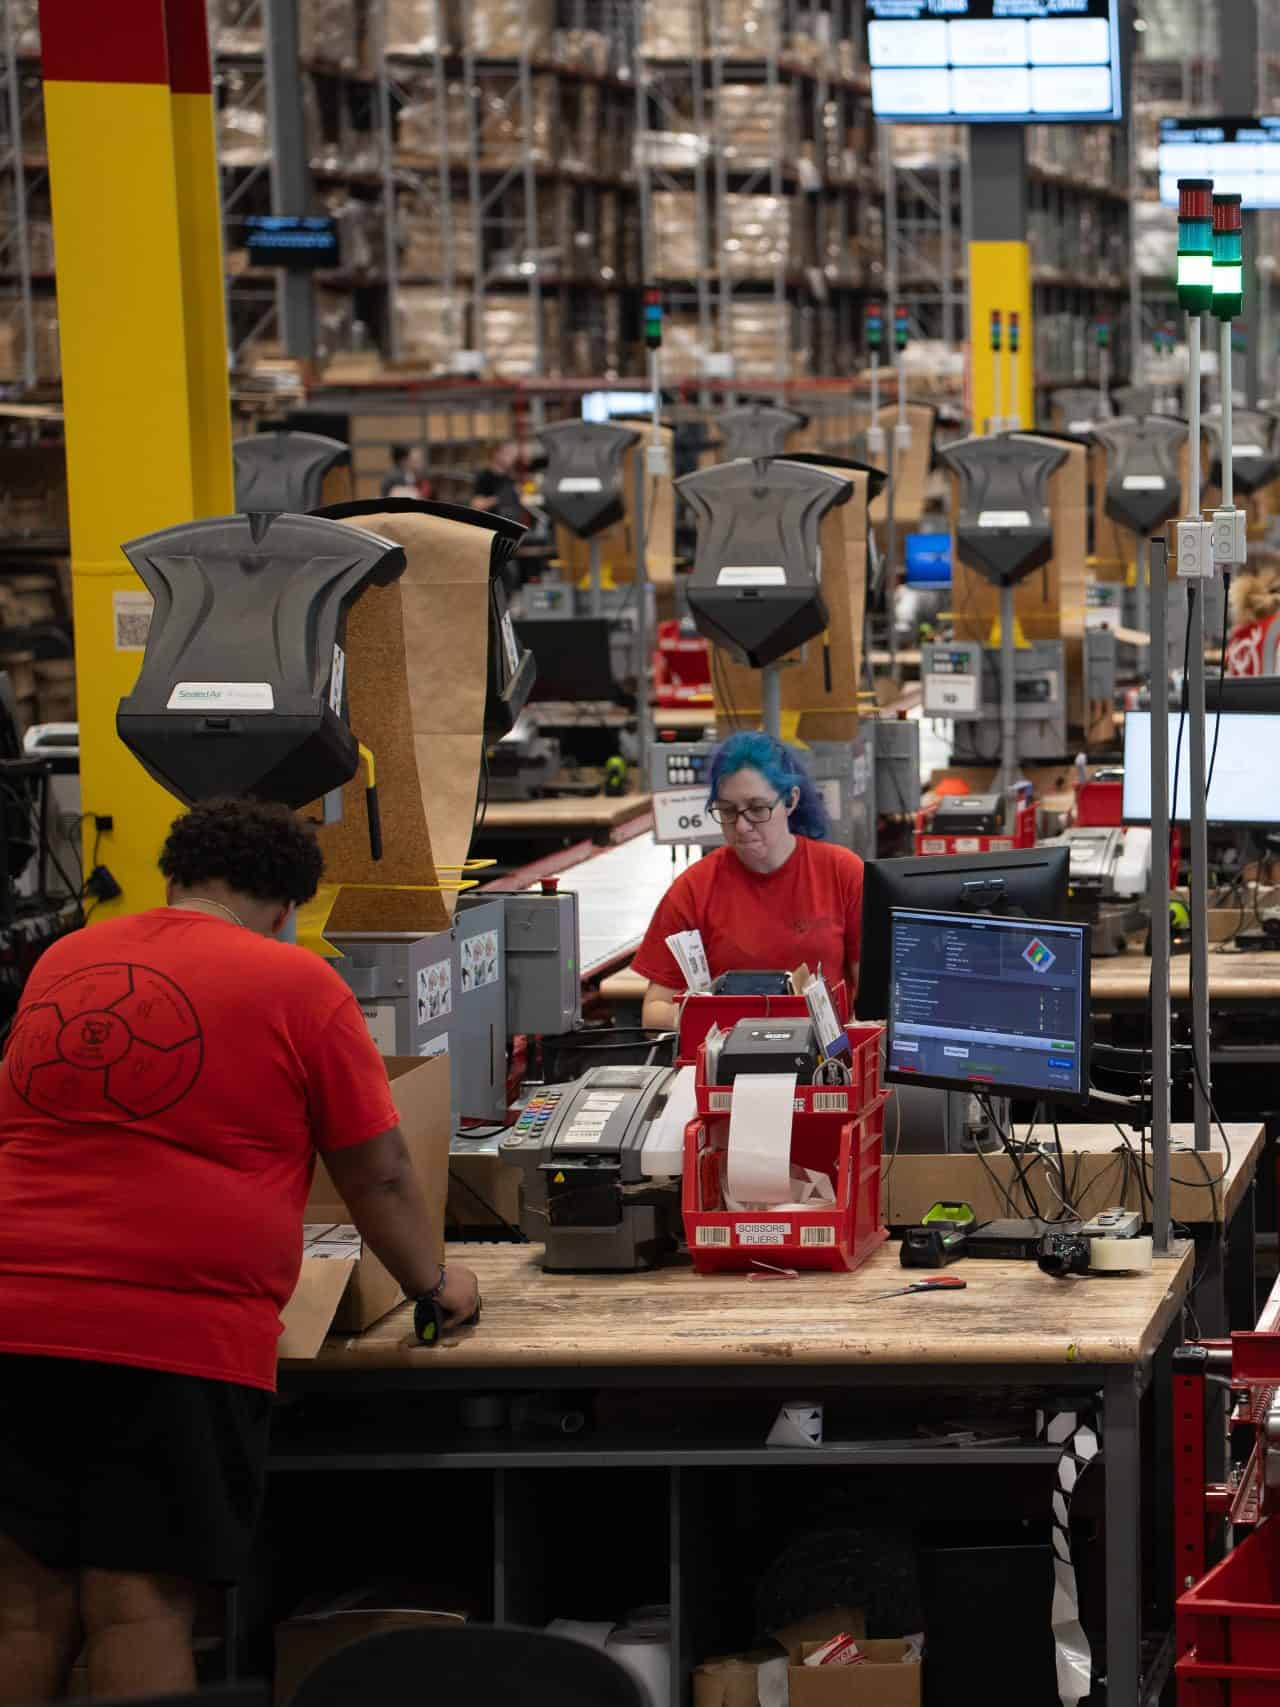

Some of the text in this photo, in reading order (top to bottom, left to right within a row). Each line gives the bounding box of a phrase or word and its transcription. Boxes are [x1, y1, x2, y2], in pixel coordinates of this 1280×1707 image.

[678, 814, 702, 829] 06
[737, 1224, 785, 1233] SCISSORS
[746, 1235, 778, 1244] PLIERS
